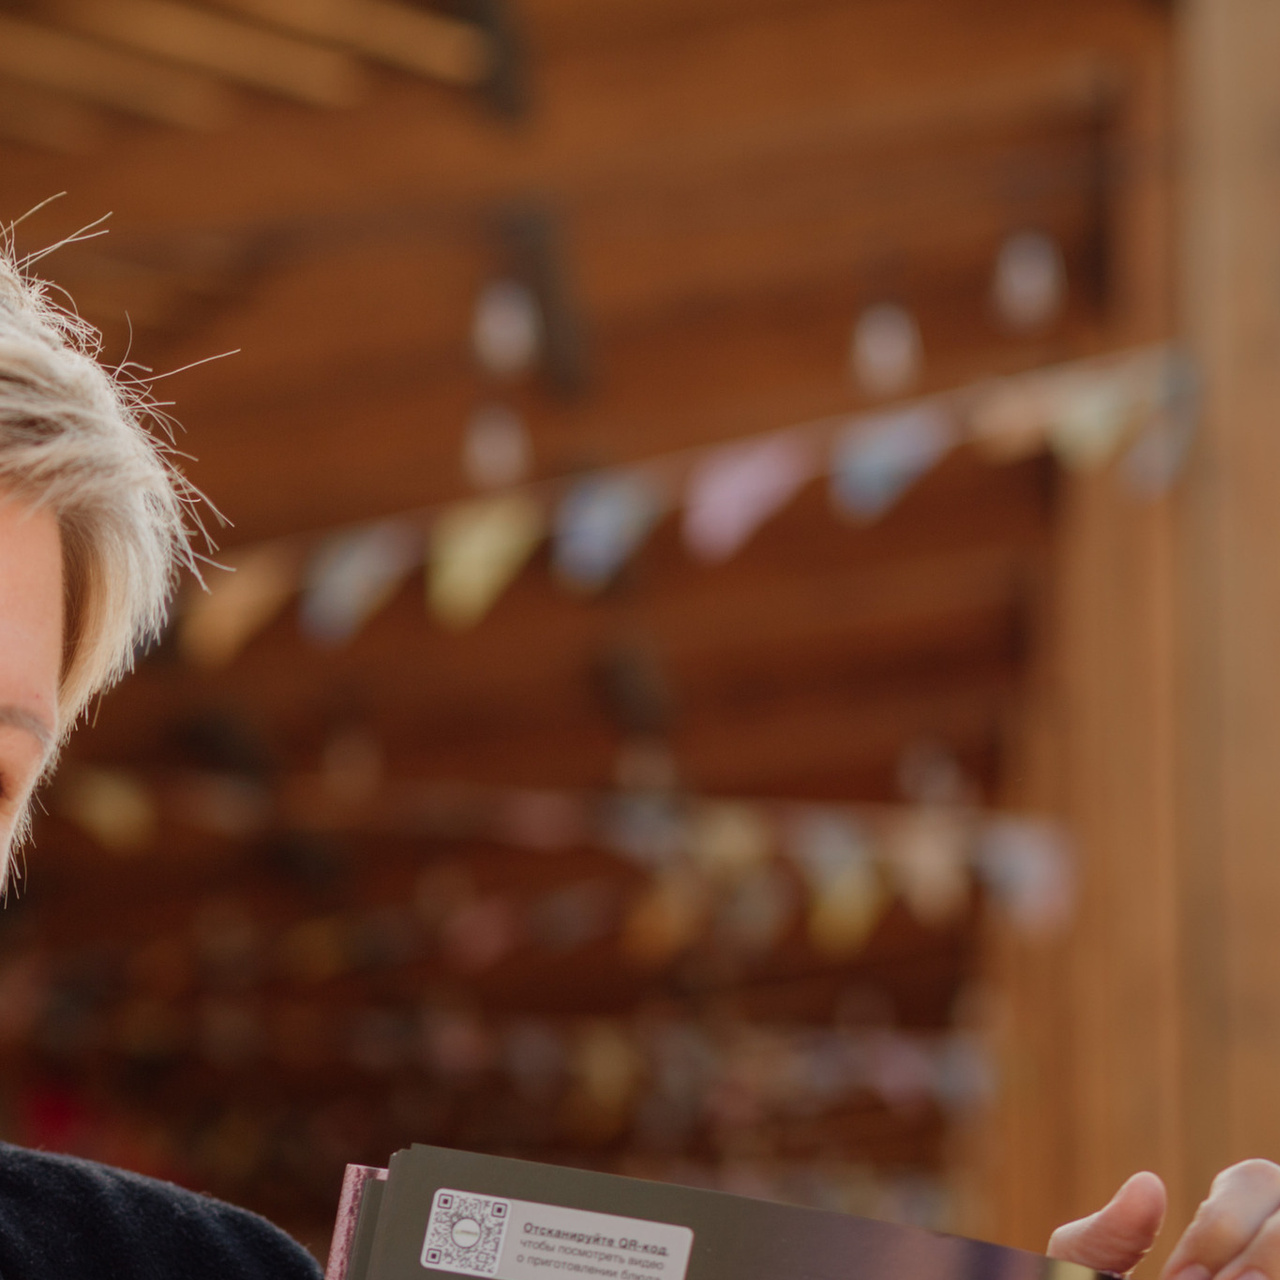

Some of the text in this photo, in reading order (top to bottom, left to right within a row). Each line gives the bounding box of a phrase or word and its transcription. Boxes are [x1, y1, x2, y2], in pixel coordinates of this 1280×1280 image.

[523, 1222, 614, 1248] Отсканируйте
[520, 1239, 664, 1271] чтобы посмотреть видео
[527, 1255, 618, 1278] приготовлении
